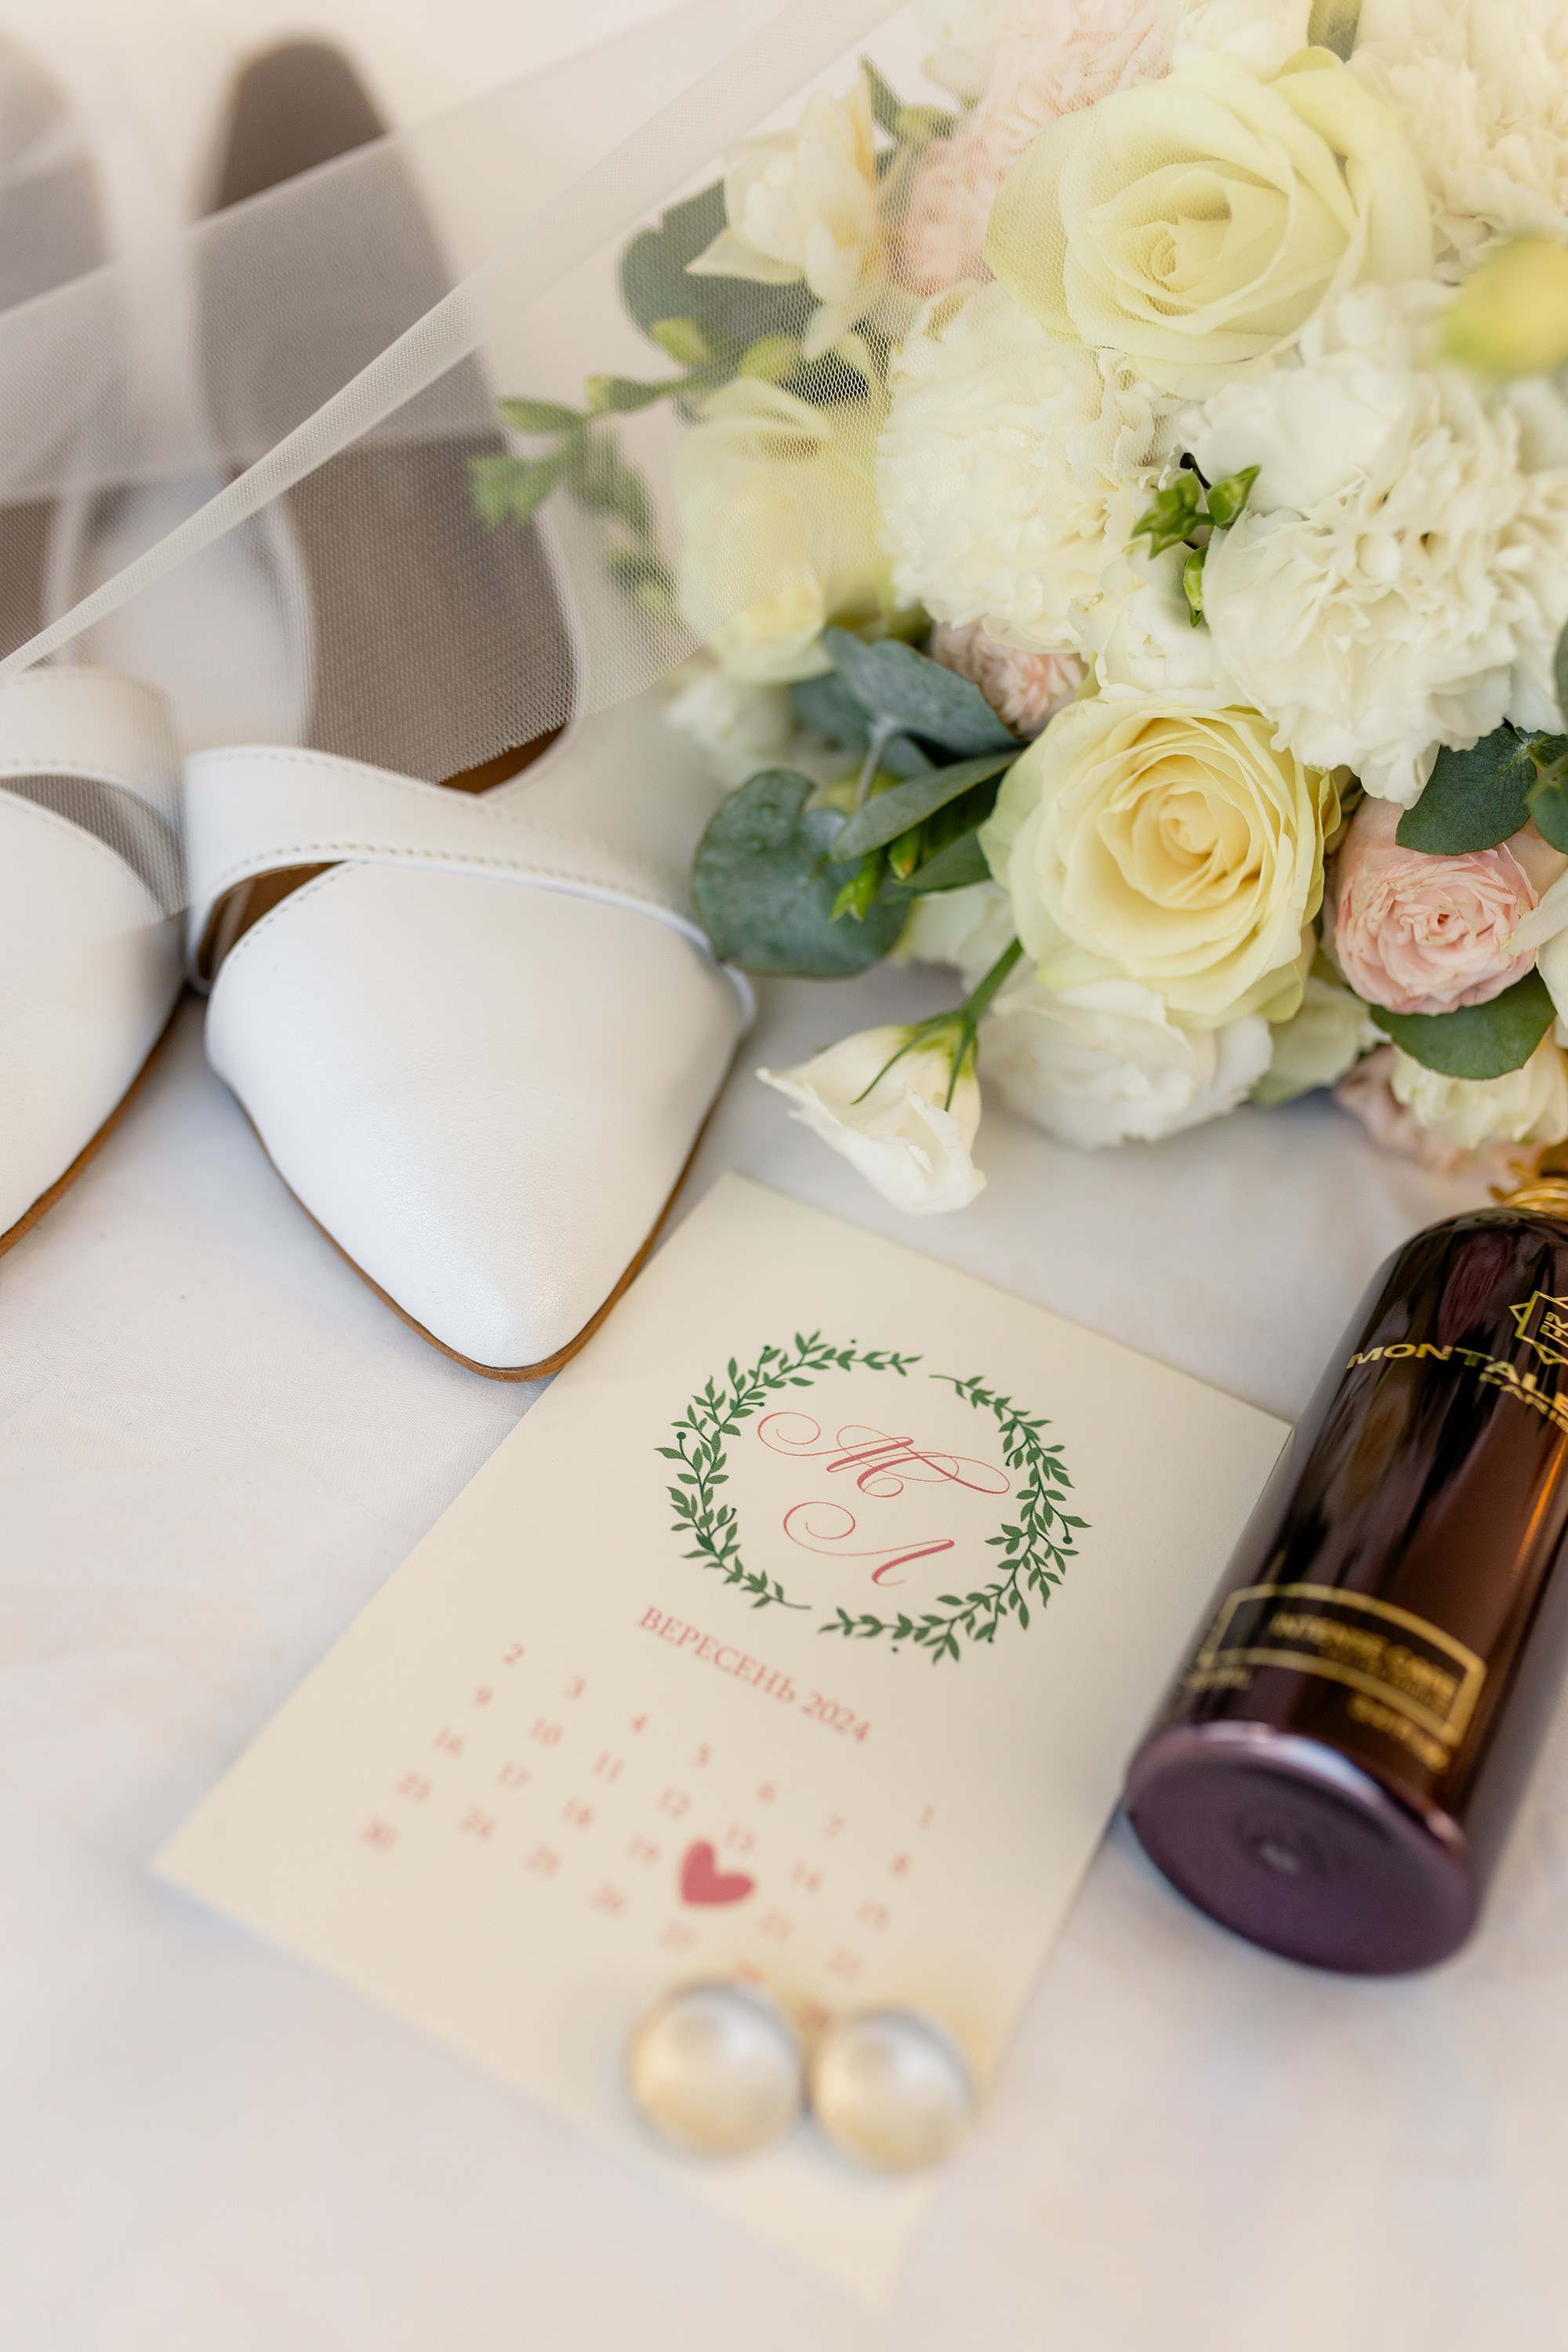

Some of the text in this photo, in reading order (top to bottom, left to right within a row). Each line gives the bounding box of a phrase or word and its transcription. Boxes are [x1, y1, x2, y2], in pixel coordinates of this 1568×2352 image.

[501, 1642, 526, 1666] 2
[564, 1675, 587, 1700] 3
[629, 1712, 650, 1735] 4
[637, 1604, 873, 1744] ВЕРЕСЕНЬ 2024
[432, 1726, 464, 1758] 16
[495, 1762, 532, 1790] 17
[474, 1684, 495, 1708] 9
[528, 1716, 564, 1748] 10
[592, 1751, 624, 1783] 11
[657, 1787, 691, 1818] 12
